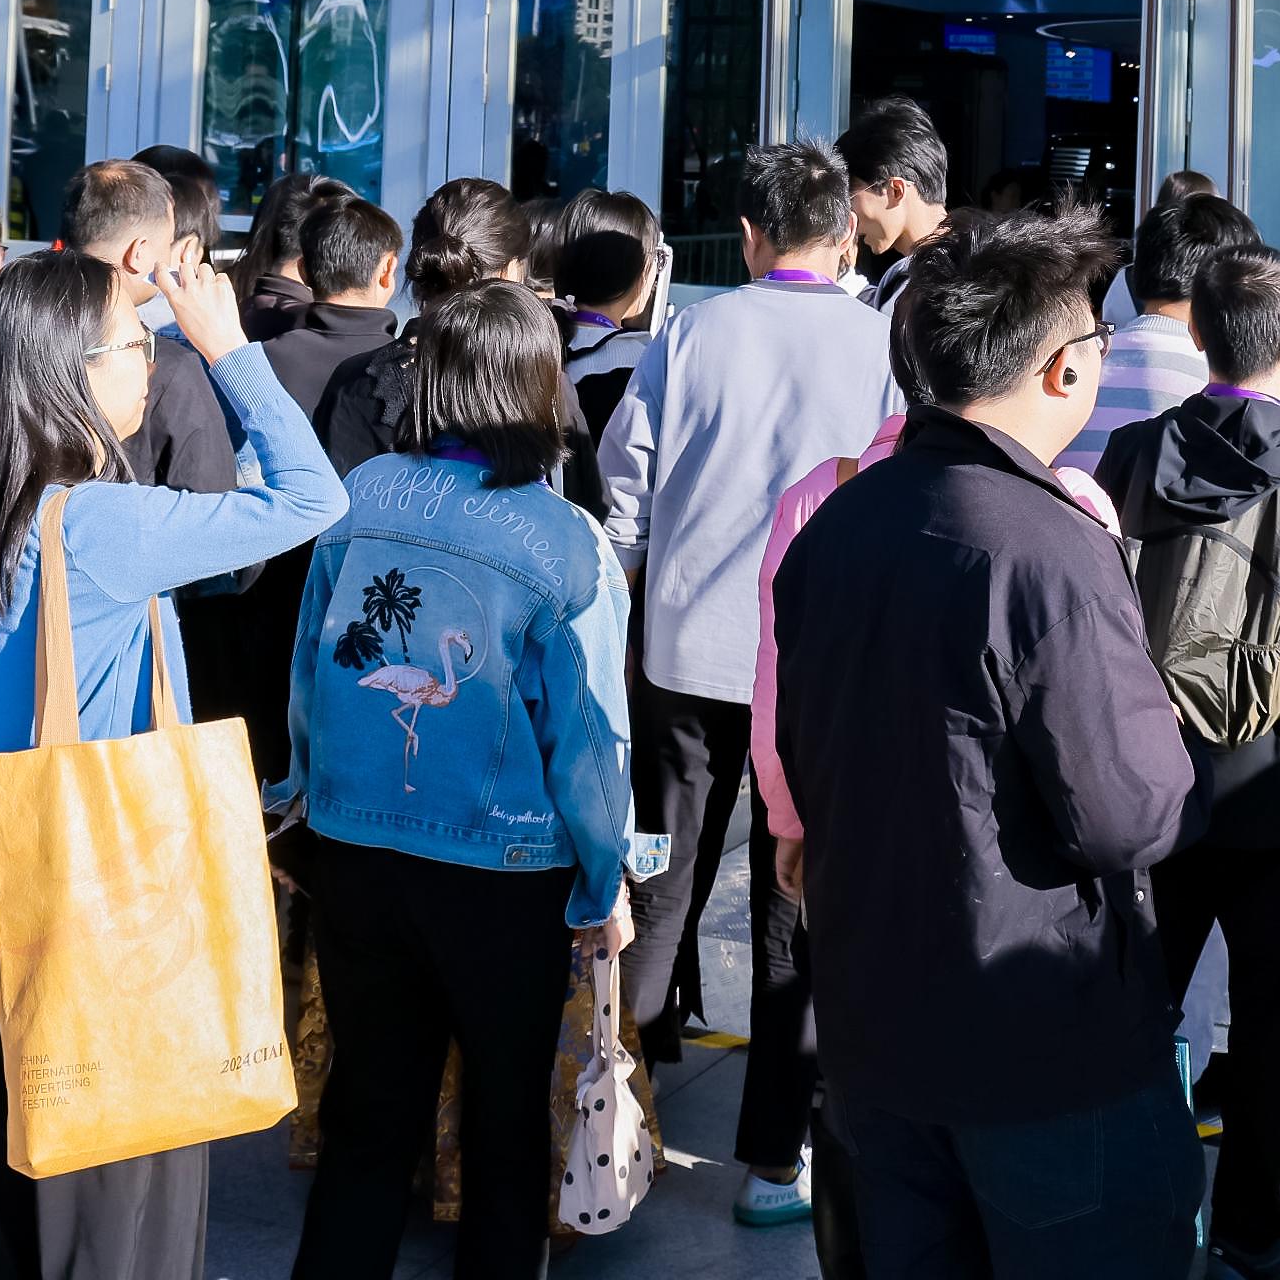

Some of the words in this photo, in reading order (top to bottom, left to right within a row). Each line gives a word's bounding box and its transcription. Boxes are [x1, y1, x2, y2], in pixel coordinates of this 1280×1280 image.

[20, 1054, 51, 1067] CHINA
[220, 1053, 251, 1074] 2024
[21, 1061, 105, 1081] INTERNATIONAL
[21, 1077, 91, 1096] ADVERTISING
[22, 1096, 71, 1112] FESTIVAL
